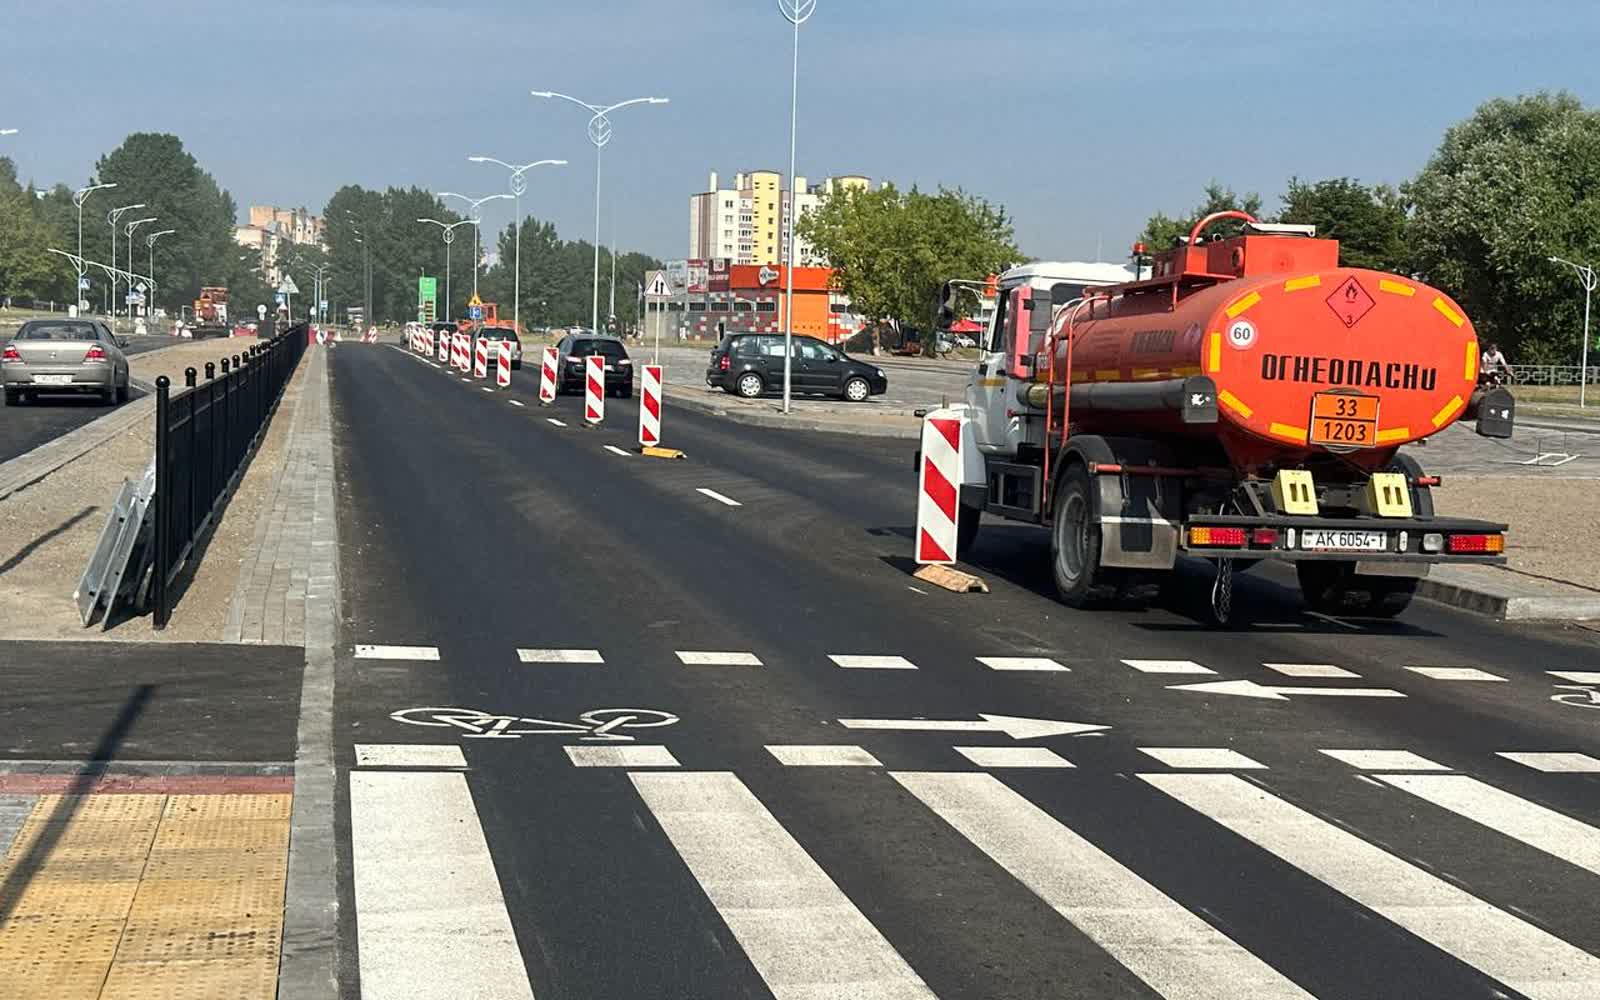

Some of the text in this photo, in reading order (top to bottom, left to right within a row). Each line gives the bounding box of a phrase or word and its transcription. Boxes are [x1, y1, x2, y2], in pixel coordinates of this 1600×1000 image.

[1346, 315, 1353, 325] 3
[1234, 327, 1250, 340] 60
[1336, 398, 1357, 416] 33
[1324, 422, 1366, 441] 1203
[1316, 531, 1384, 547] AK 6054-1
